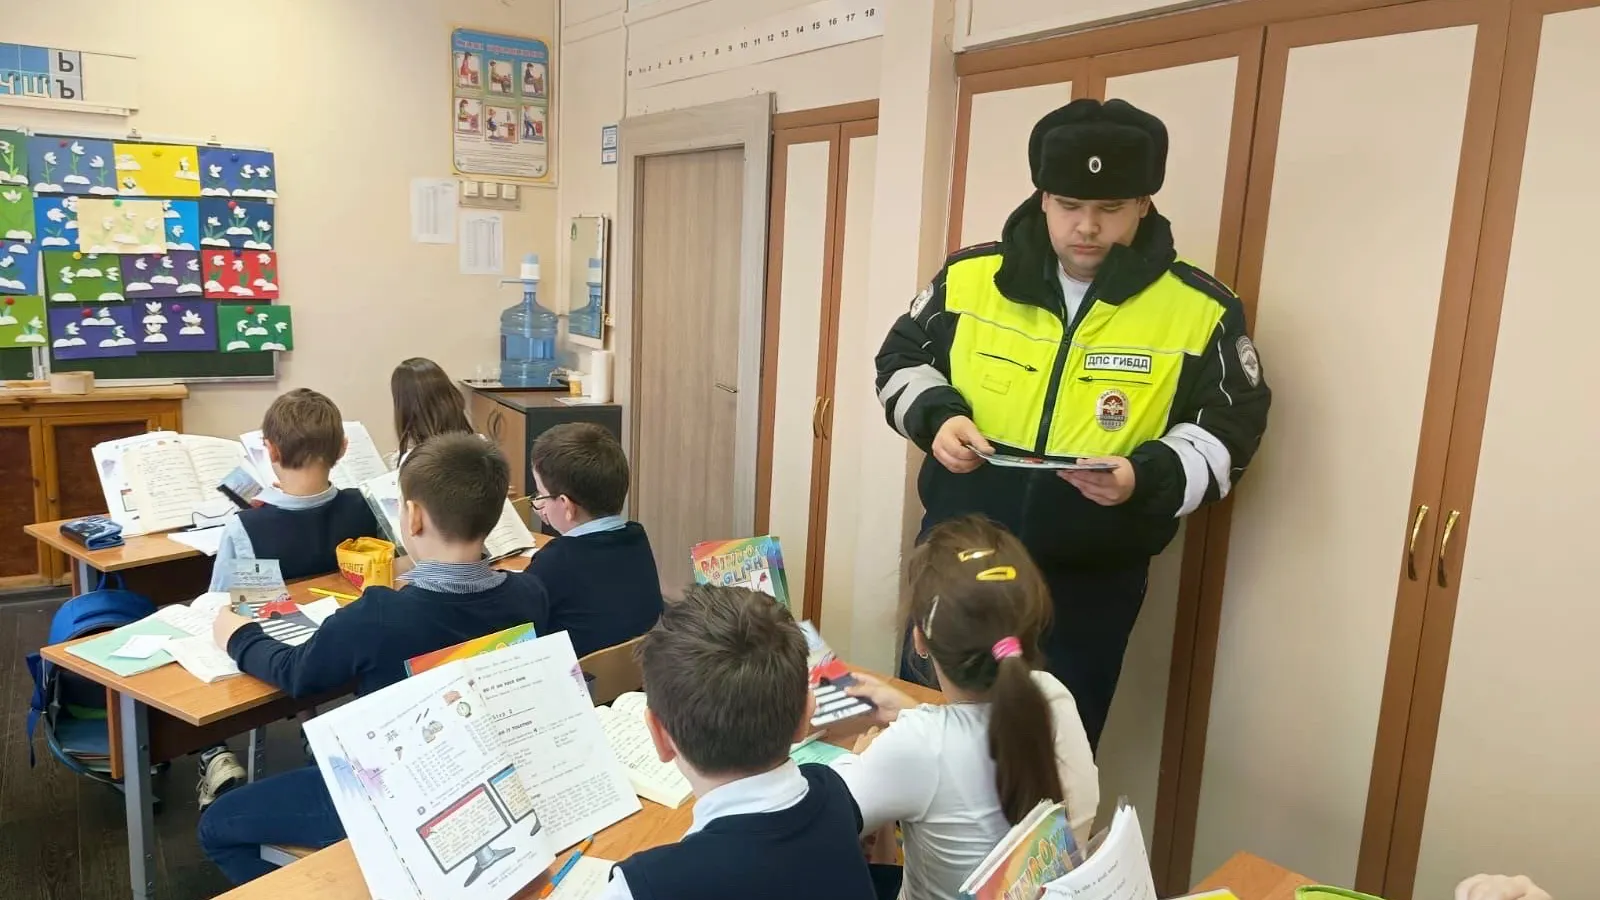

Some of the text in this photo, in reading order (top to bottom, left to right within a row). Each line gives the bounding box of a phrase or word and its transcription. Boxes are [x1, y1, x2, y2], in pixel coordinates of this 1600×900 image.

[740, 41, 748, 49] 10
[754, 38, 761, 46] 11
[767, 34, 774, 42] 12
[781, 30, 789, 38] 13
[796, 26, 804, 34] 14
[812, 21, 821, 31] 15
[829, 17, 838, 26] 16
[846, 13, 855, 22] 17
[864, 8, 875, 18] 18
[58, 51, 74, 72] Ь
[56, 79, 75, 99] Ъ
[1088, 356, 1148, 370] ДПС ГИБДД
